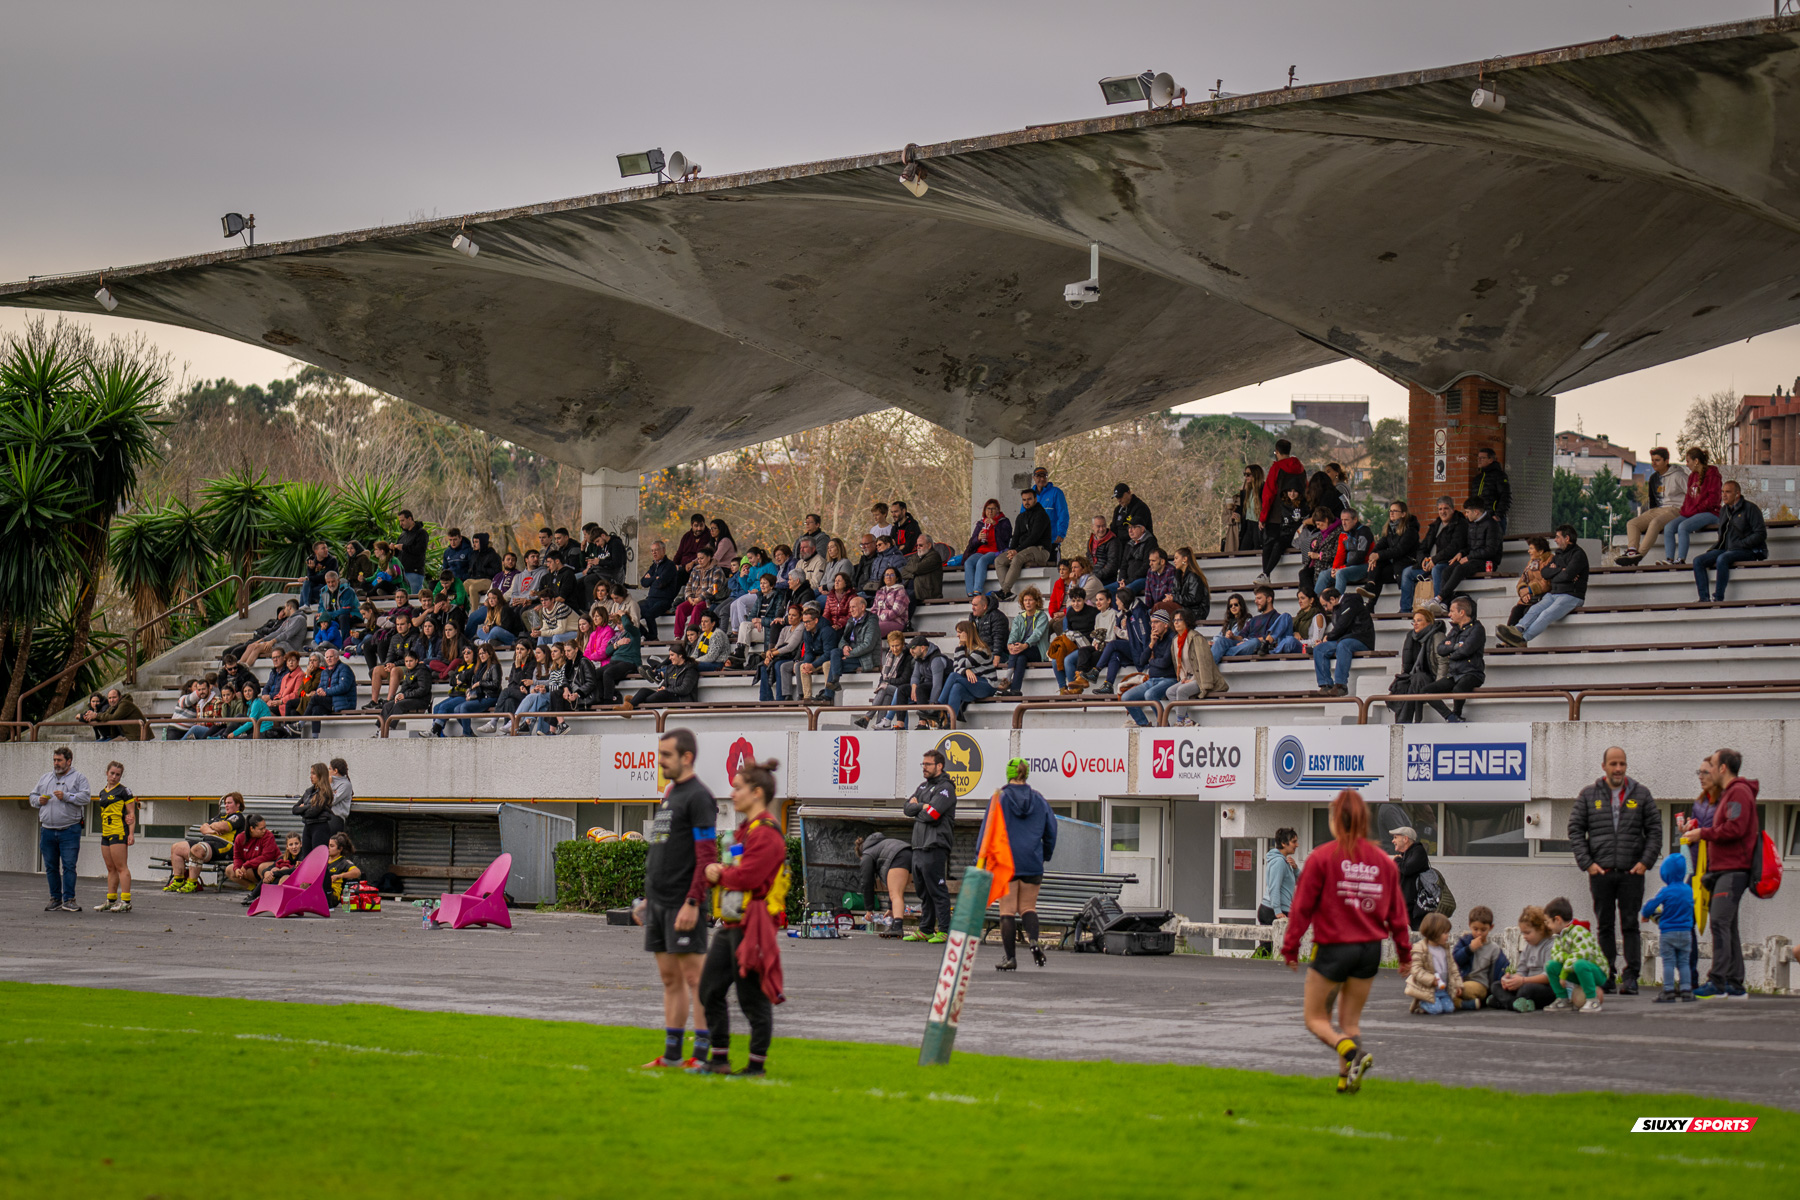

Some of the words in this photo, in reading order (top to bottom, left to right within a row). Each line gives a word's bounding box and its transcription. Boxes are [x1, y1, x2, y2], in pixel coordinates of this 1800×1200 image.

[614, 751, 656, 769] SOLAR
[1178, 739, 1241, 768] Getxo
[1079, 757, 1126, 773] VEOLIA
[1308, 754, 1331, 771] EASY
[1333, 754, 1364, 771] TRUCK
[1437, 750, 1522, 775] SENER
[630, 771, 656, 781] PACK
[950, 774, 970, 786] etxo
[1341, 859, 1380, 877] Getxo
